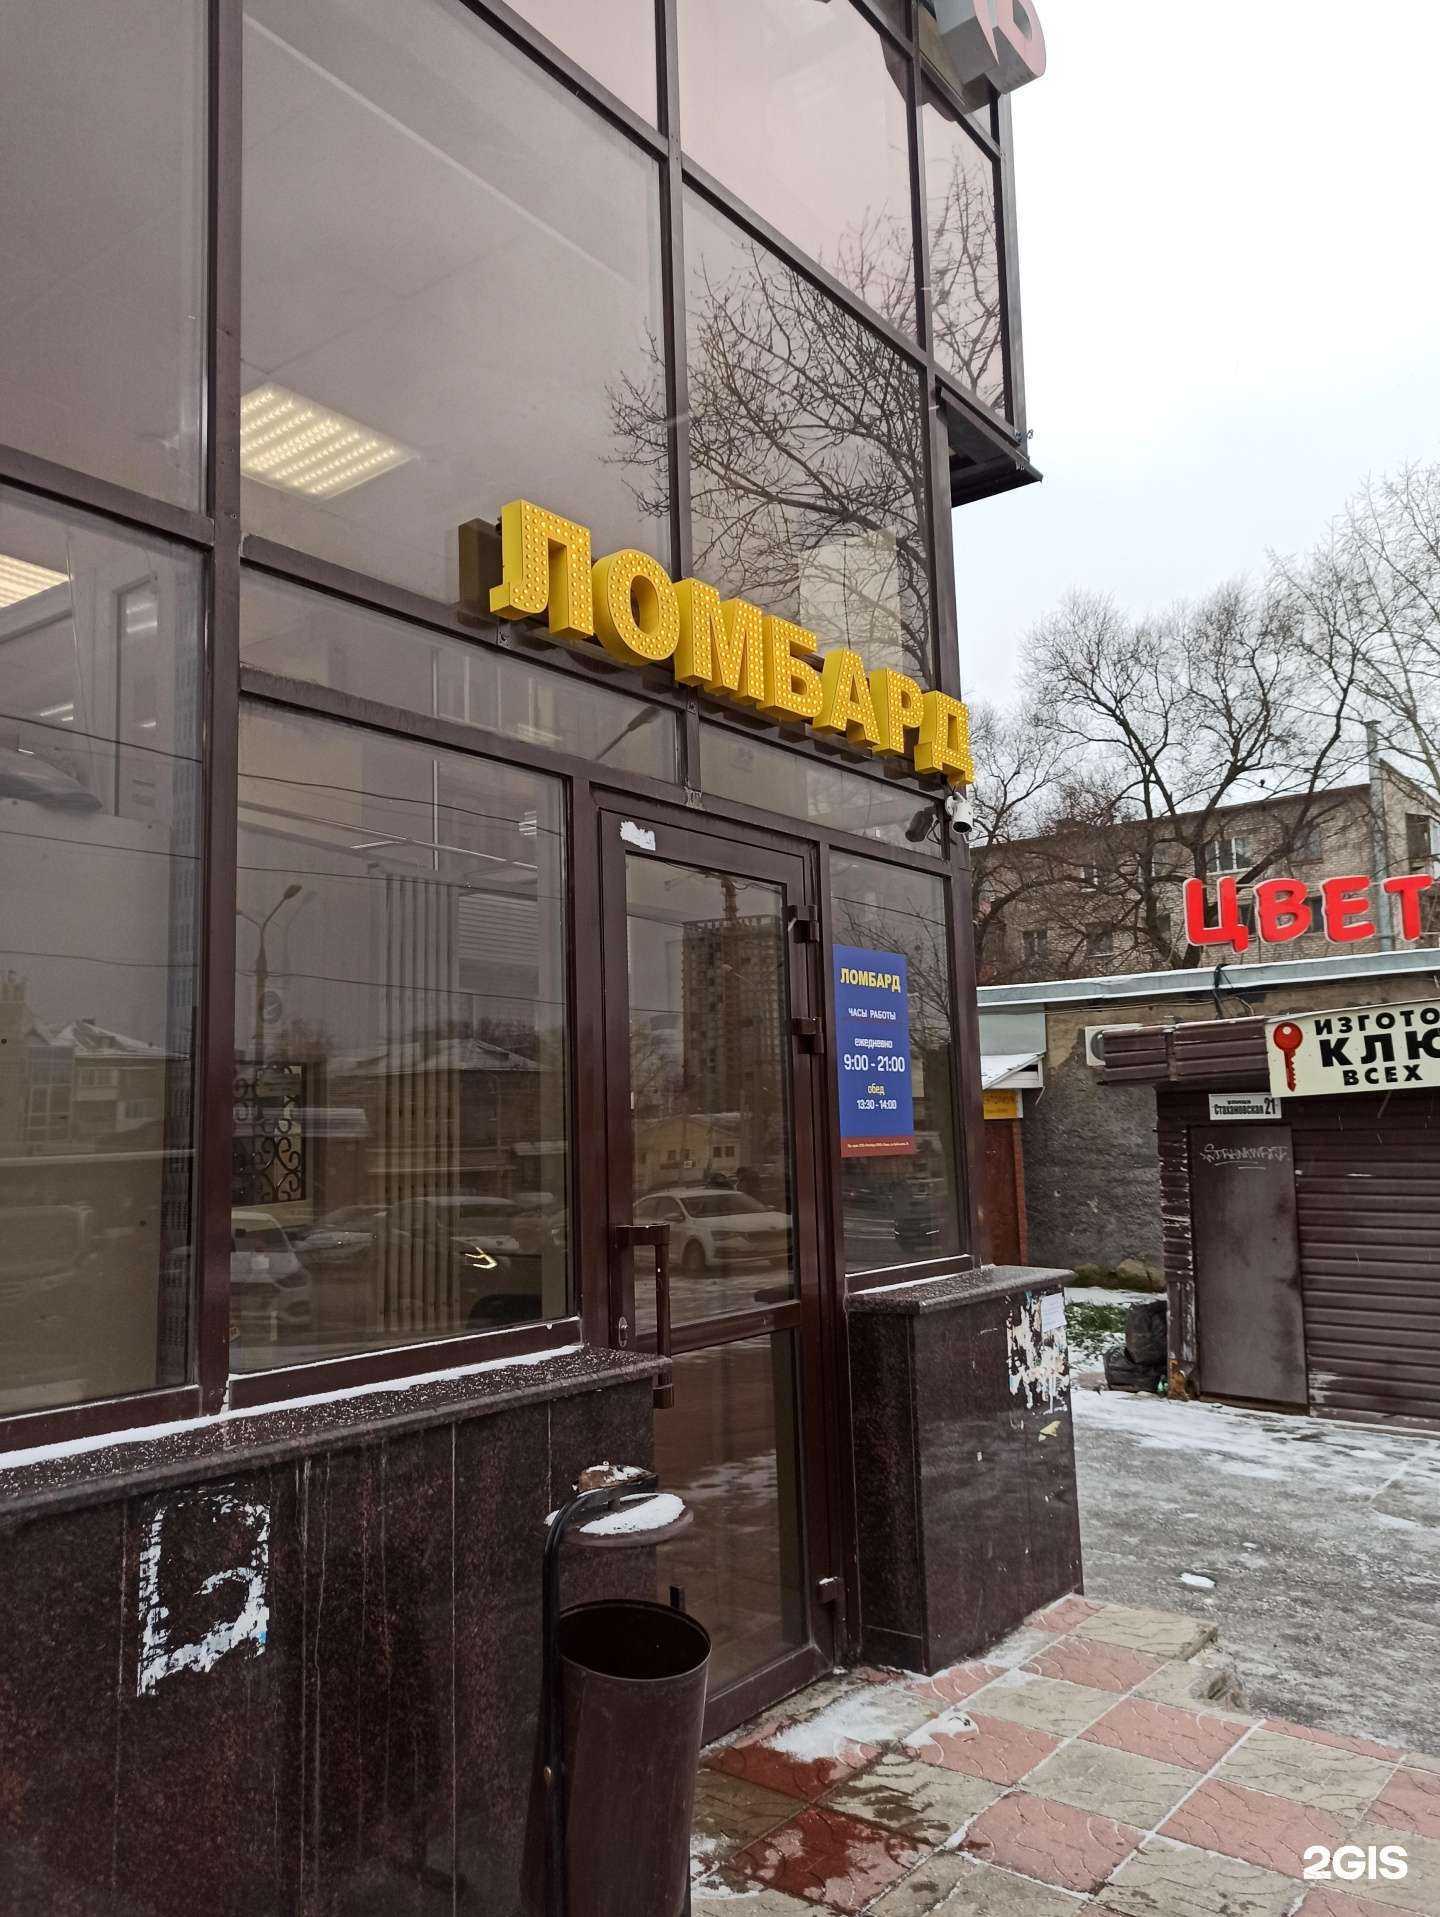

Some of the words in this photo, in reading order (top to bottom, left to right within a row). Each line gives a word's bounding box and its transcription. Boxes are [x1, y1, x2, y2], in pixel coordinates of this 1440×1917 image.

[490, 499, 975, 785] ЛОМБАРД
[1183, 874, 1434, 953] ЦВЕТ
[840, 968, 901, 993] ЛОМБАРД
[848, 1007, 868, 1018] ЧАСЫ
[870, 1010, 896, 1020] РАБОТЫ
[1314, 1007, 1440, 1036] ИЗГОТО
[854, 1038, 893, 1049] ежедневно
[1319, 1027, 1440, 1067] КЛЮ
[843, 1053, 869, 1071] 9:00
[877, 1055, 906, 1072] 21:00
[1342, 1064, 1423, 1086] ВСЕХ
[867, 1083, 886, 1096] обед
[856, 1099, 875, 1110] 13:30
[879, 1099, 897, 1110] 14:00
[1264, 1097, 1276, 1115] 21
